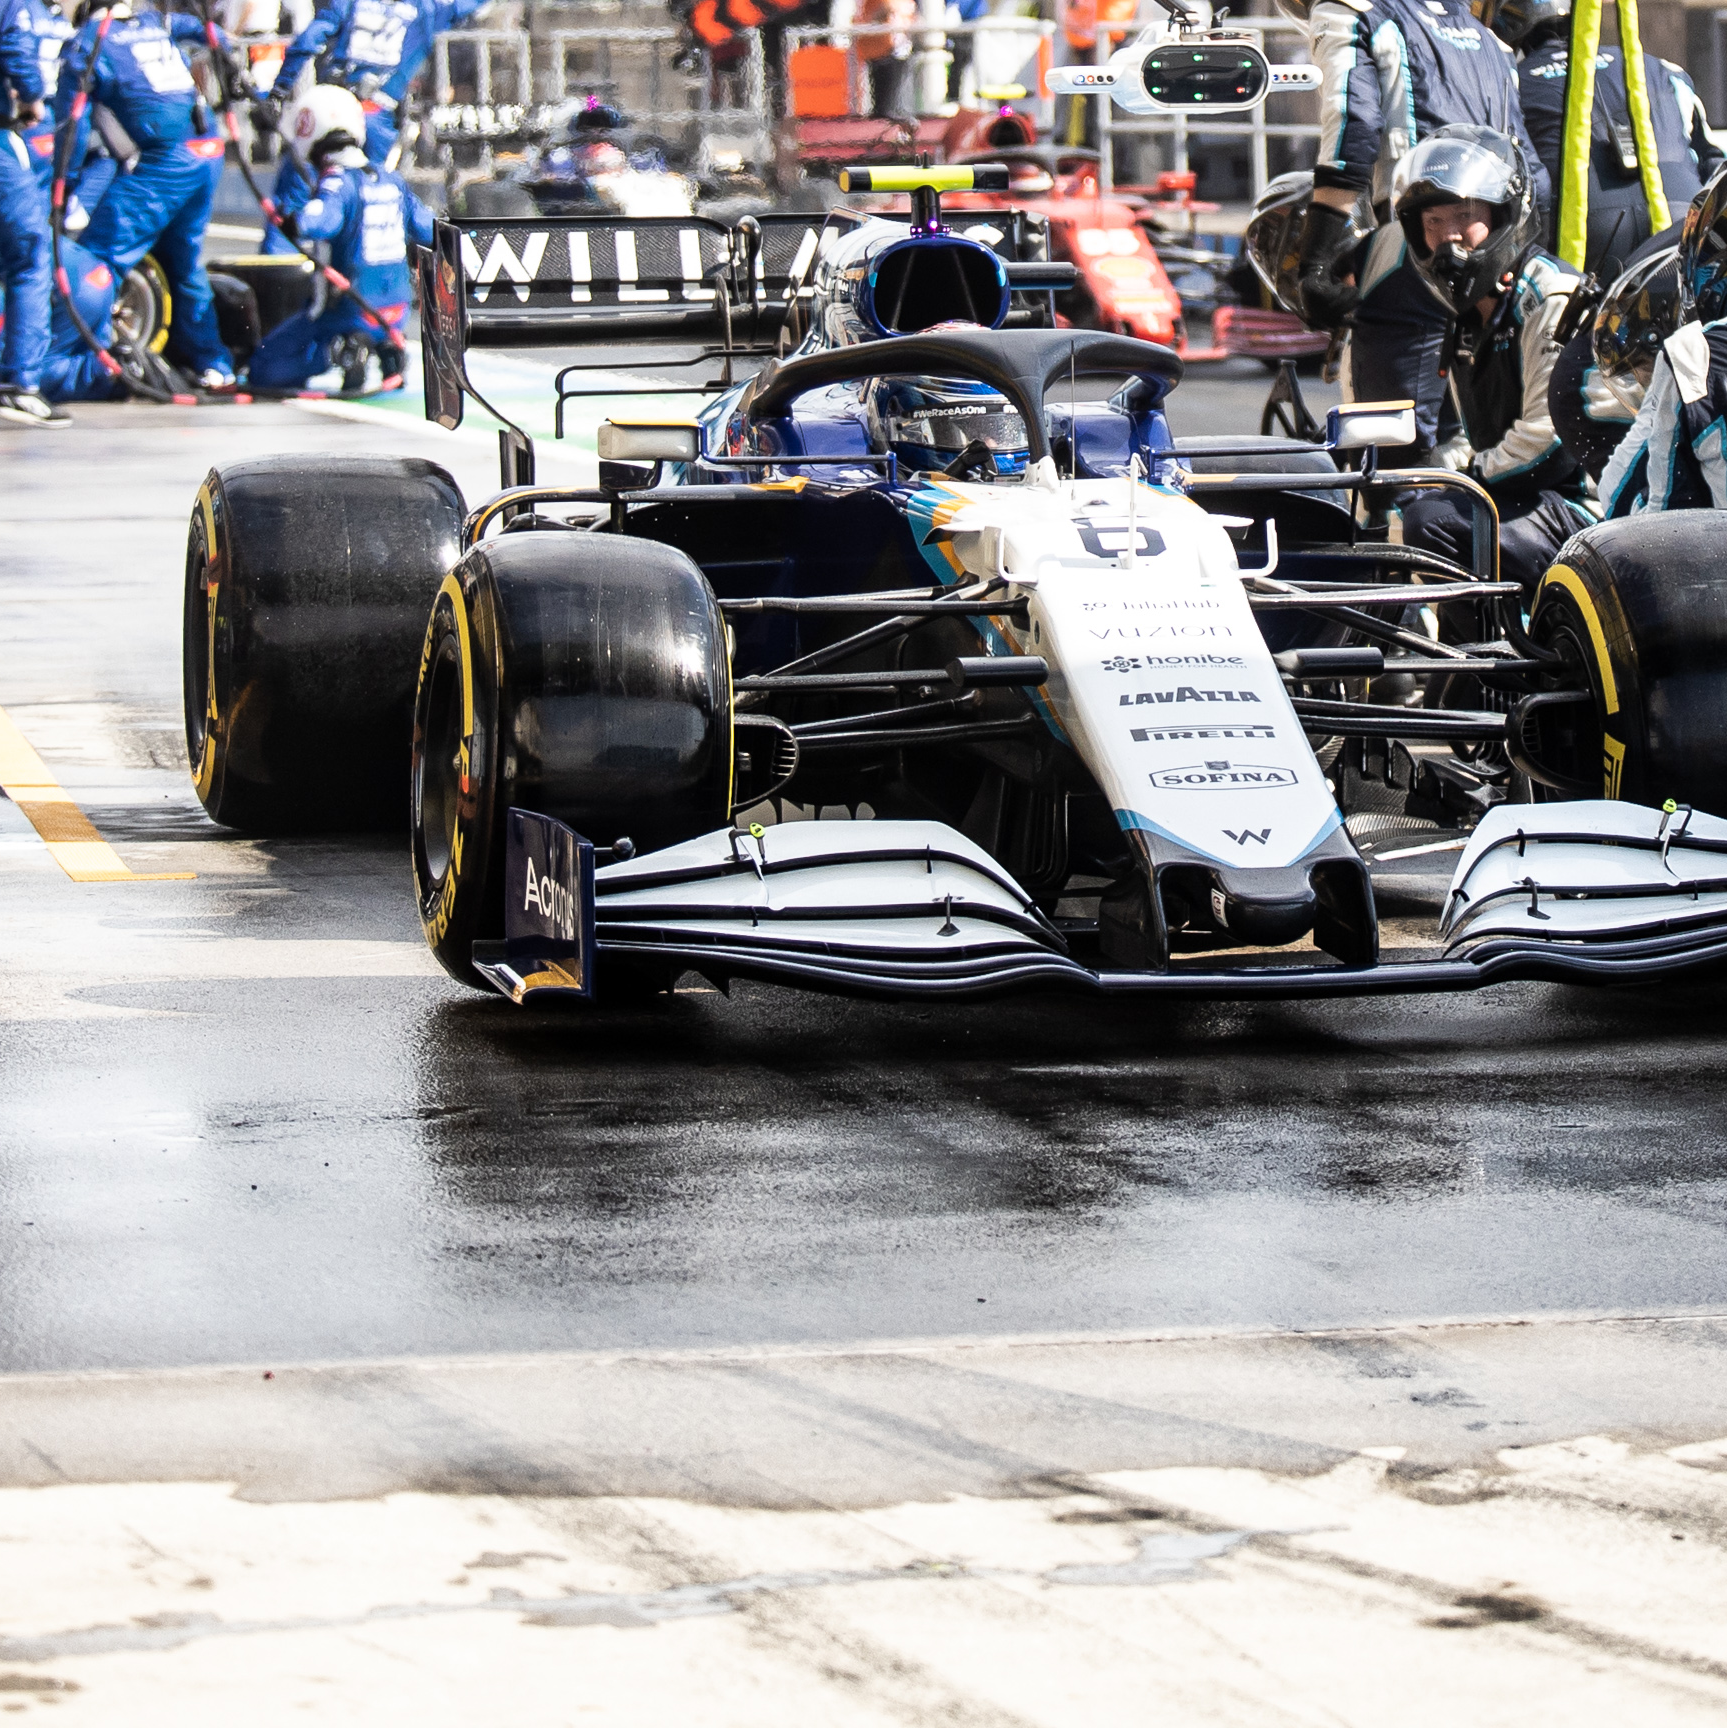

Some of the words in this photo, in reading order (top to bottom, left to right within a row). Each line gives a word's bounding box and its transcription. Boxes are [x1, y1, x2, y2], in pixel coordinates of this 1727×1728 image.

[913, 405, 987, 419] #WeRaceAsOne
[1146, 654, 1244, 665] honibe
[1119, 687, 1262, 706] LAVAZZA
[1130, 725, 1276, 742] PIRELLI
[1162, 773, 1288, 785] SOFINA
[524, 857, 574, 936] Acronis
